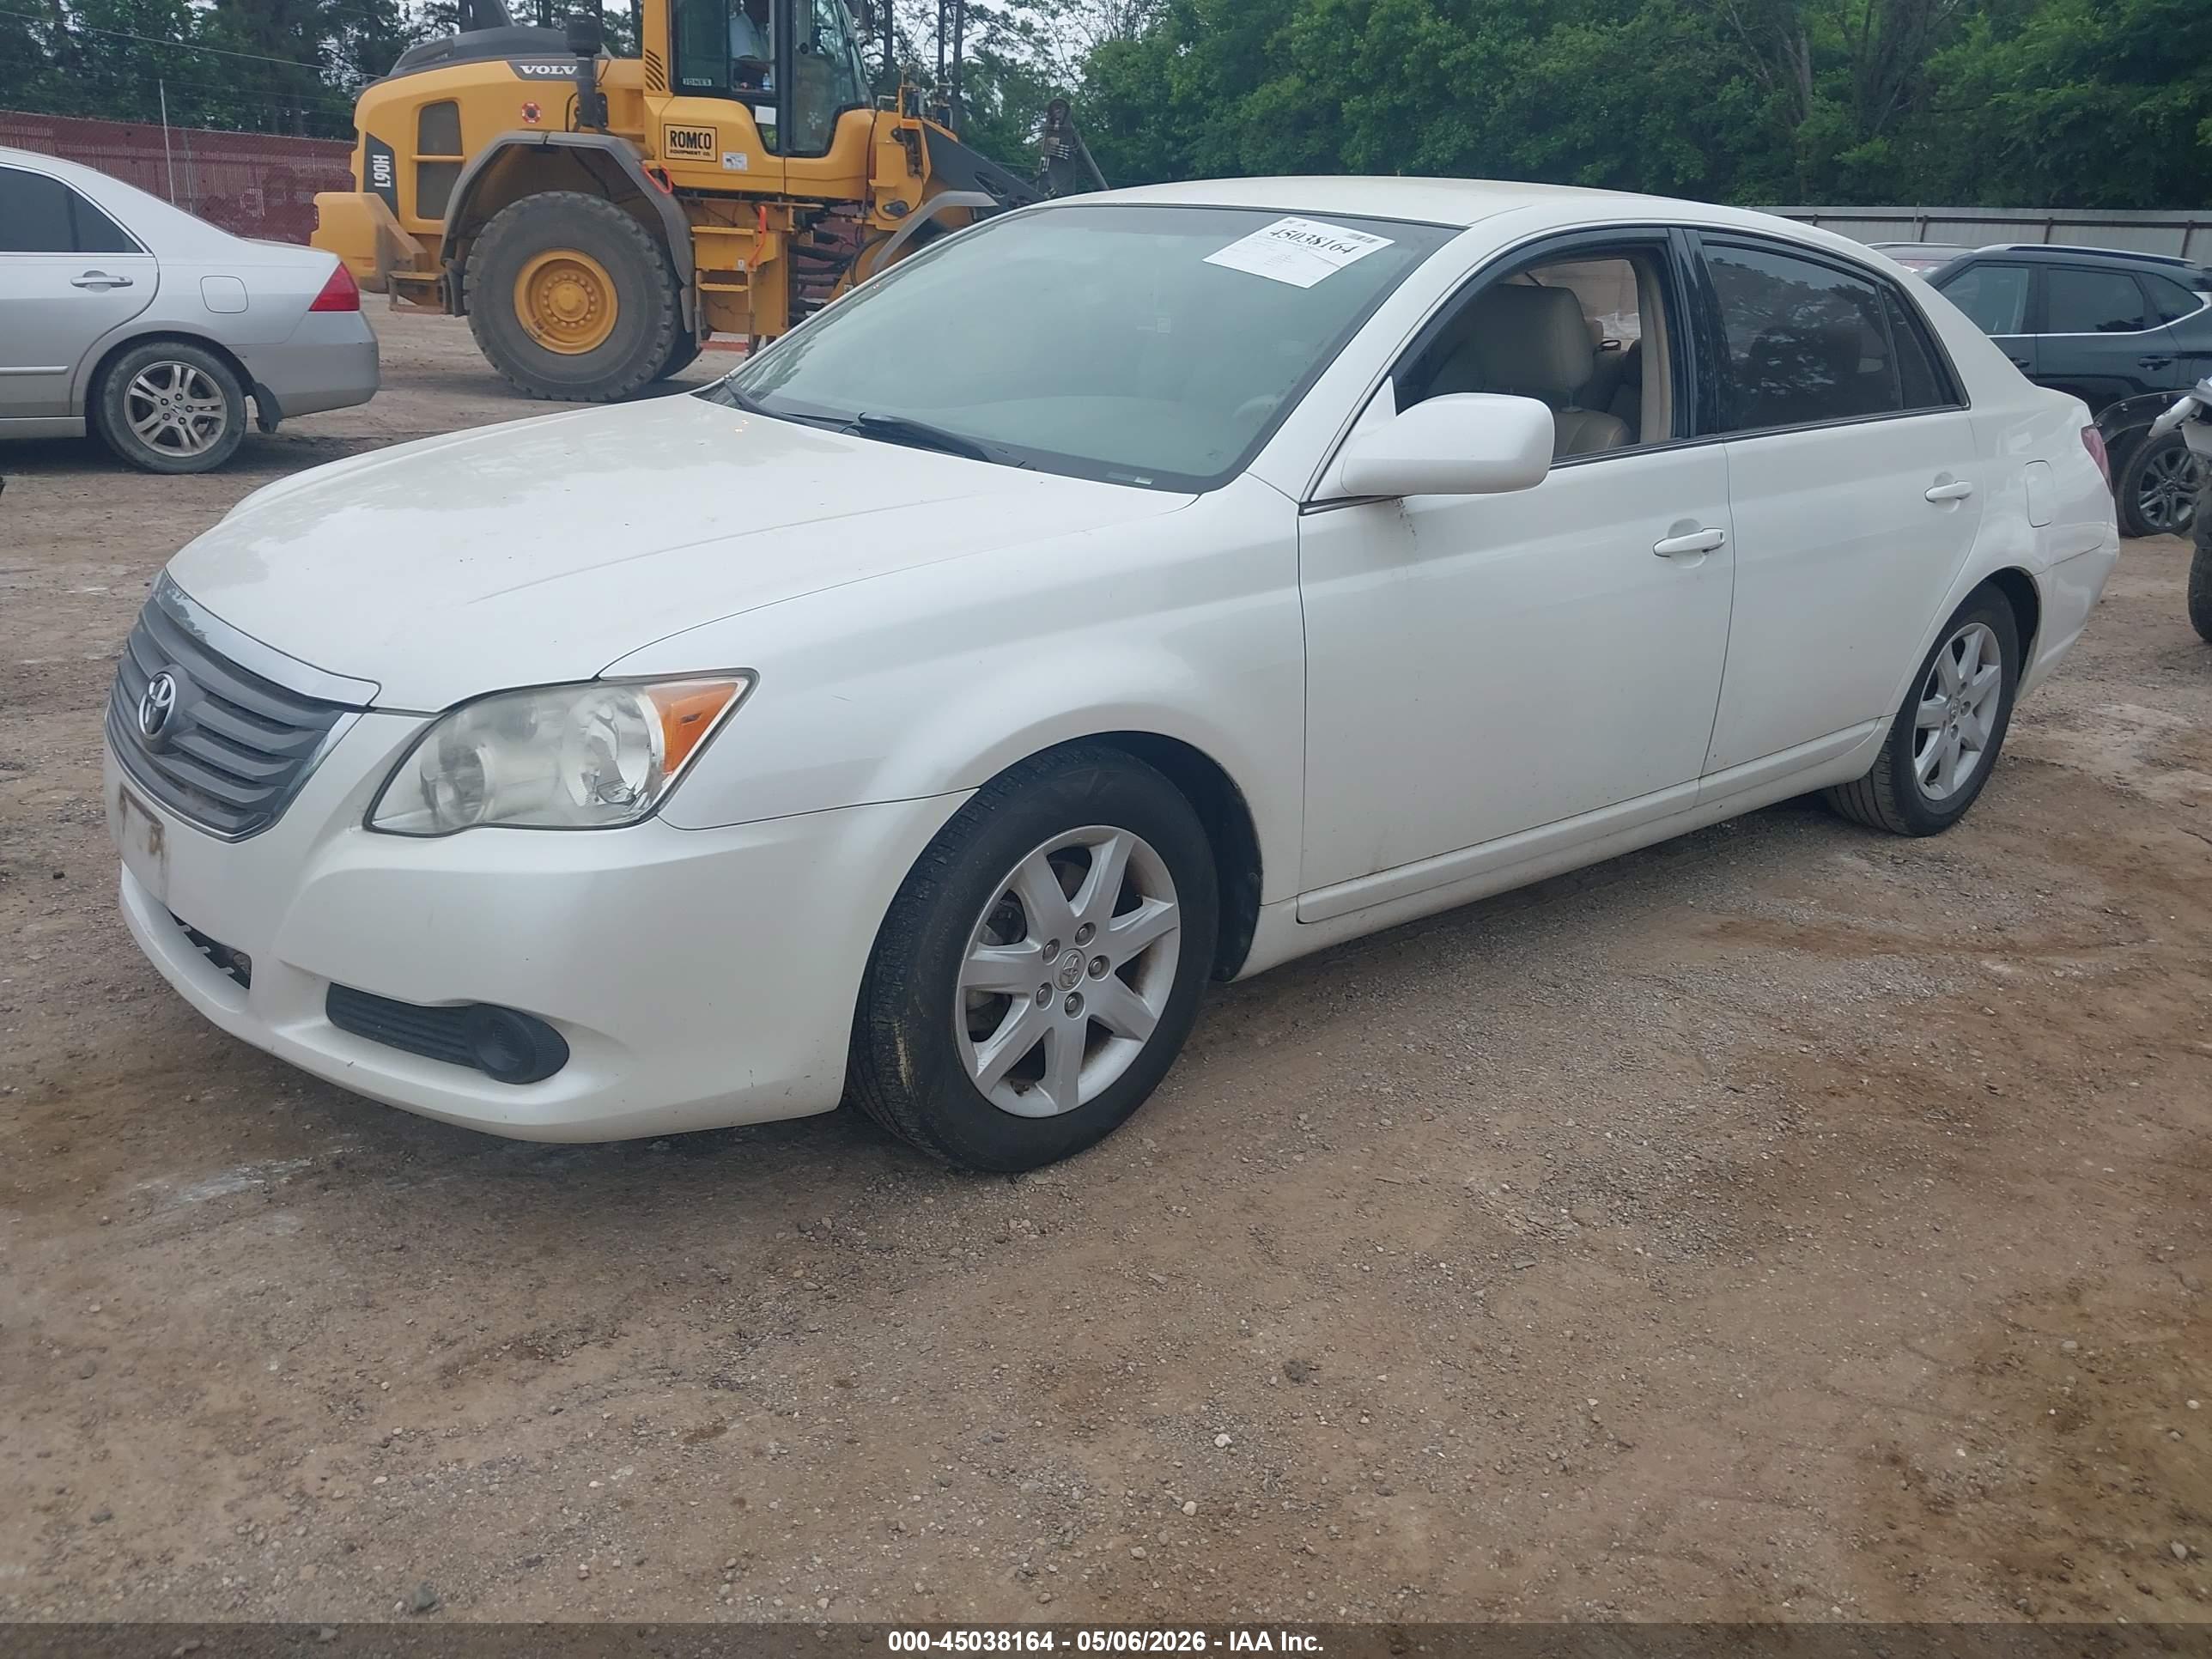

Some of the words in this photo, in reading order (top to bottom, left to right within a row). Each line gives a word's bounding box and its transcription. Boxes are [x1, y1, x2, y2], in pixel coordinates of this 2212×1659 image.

[520, 65, 577, 75] VOLV
[670, 130, 712, 150] ROMCO
[372, 155, 392, 187] L90H
[1269, 228, 1360, 254] 45038164
